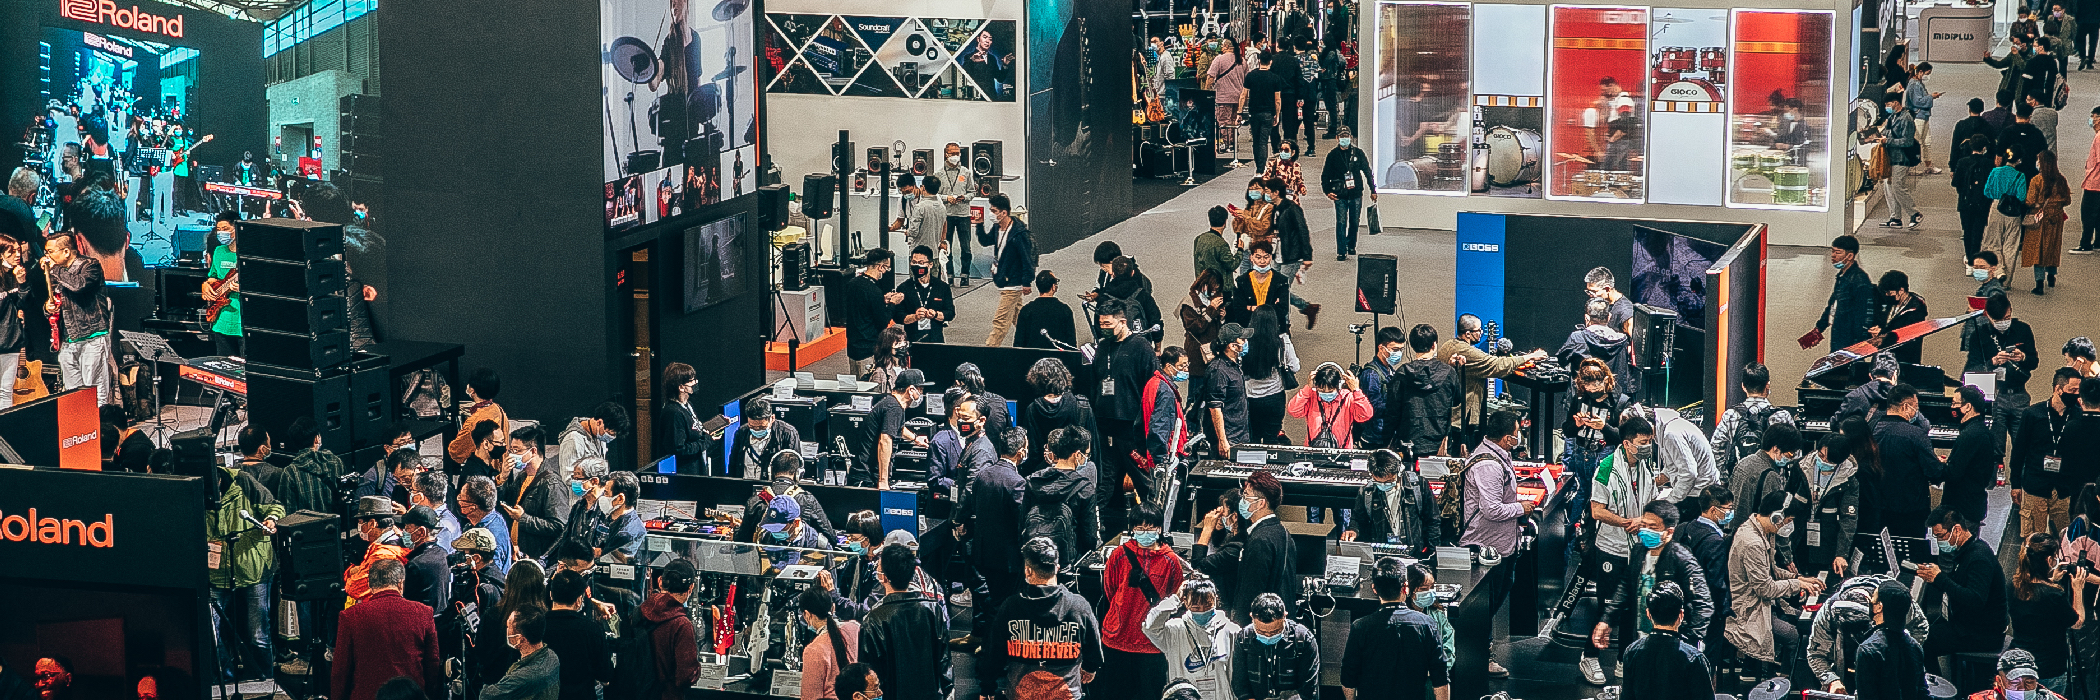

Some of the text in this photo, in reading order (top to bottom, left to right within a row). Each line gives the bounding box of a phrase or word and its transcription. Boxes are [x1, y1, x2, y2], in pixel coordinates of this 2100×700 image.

[99, 0, 183, 38] Roland
[858, 23, 890, 32] Soundcraft
[100, 36, 133, 58] Roland
[1469, 243, 1499, 252] BOSS
[72, 429, 97, 446] Roland
[890, 508, 914, 517] BOSS
[0, 507, 114, 548] oland
[1562, 574, 1585, 609] Roland
[1007, 619, 1080, 646] SILENCE
